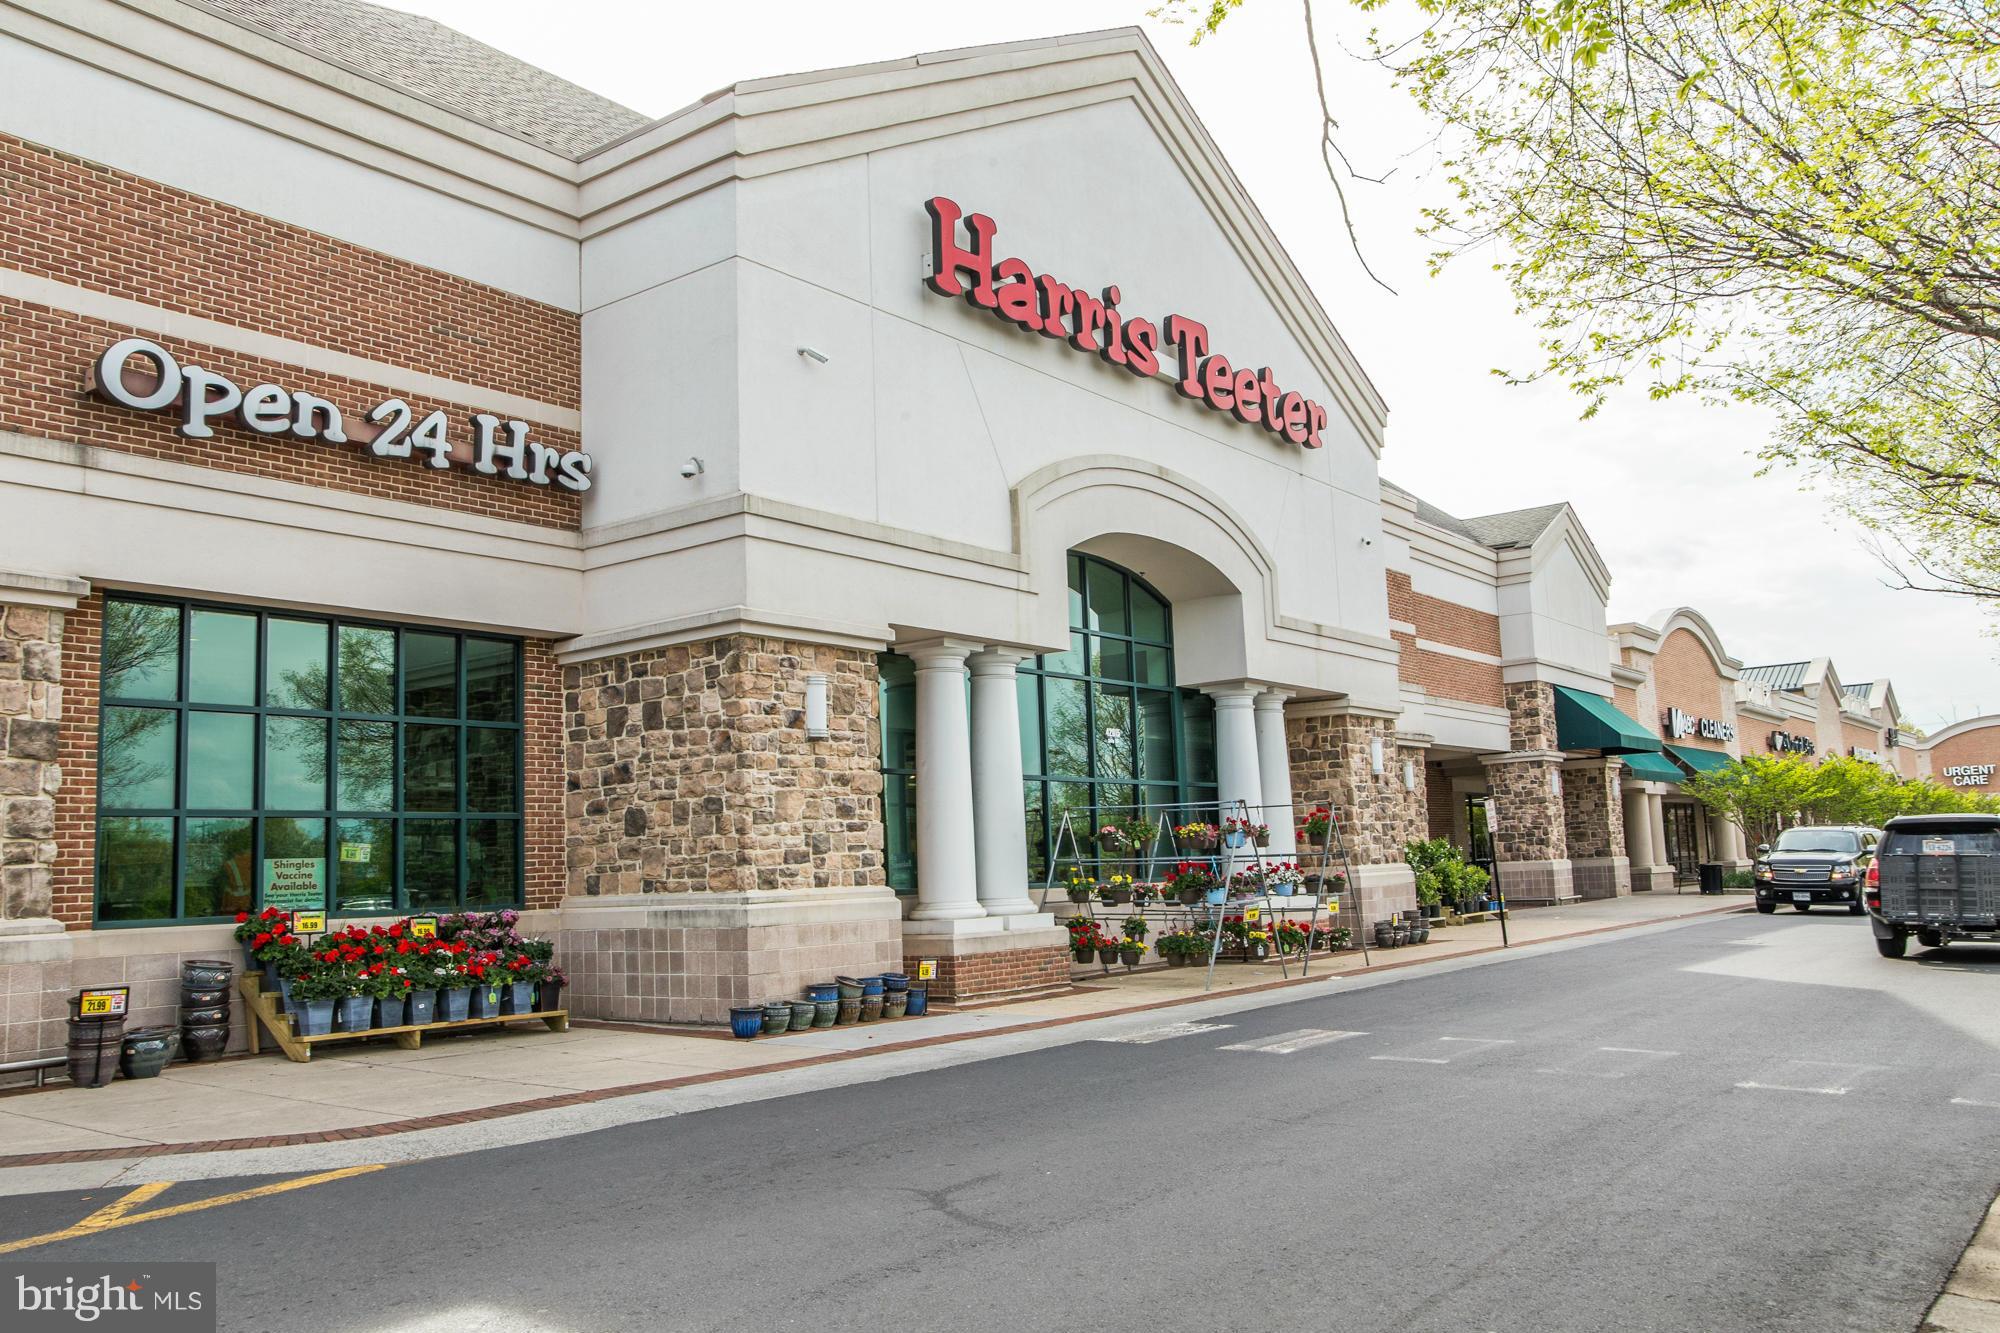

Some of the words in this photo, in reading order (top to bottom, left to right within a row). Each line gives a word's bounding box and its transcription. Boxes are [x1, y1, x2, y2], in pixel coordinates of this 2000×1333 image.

[925, 197, 1160, 378] Harris
[1164, 314, 1328, 450] Teeter
[94, 338, 348, 439] Open
[366, 398, 453, 469] 24
[469, 414, 593, 492] Hrs
[1701, 718, 1735, 742] CLEANERS
[1943, 764, 1996, 777] URGENT
[1952, 775, 1989, 786] CARE
[273, 860, 316, 871] Shingles
[275, 871, 313, 880] Vaccine
[271, 881, 317, 891] Available
[87, 1000, 106, 1011] 21.99
